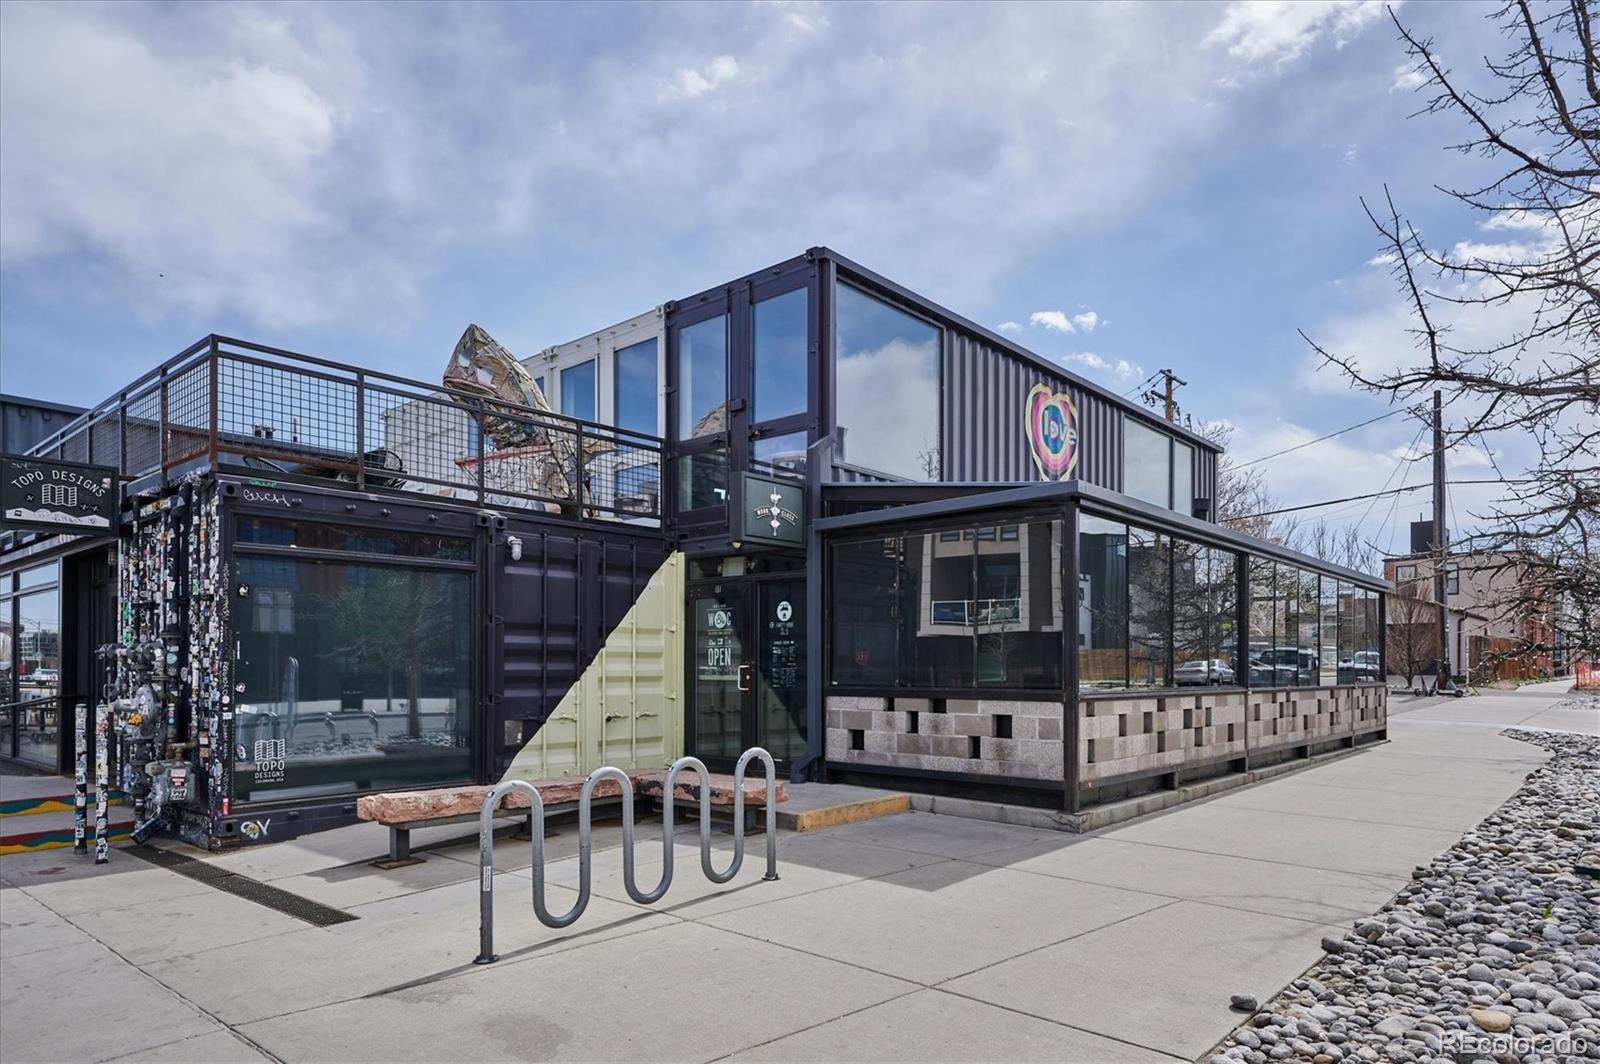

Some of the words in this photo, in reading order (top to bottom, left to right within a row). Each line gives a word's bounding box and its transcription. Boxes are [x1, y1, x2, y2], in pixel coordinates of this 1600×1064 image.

[11, 470, 44, 489] TOPO
[52, 470, 106, 498] DESIGNS
[708, 648, 731, 666] OPEN
[255, 760, 285, 771] TOPO
[255, 771, 285, 779] DESIGNS
